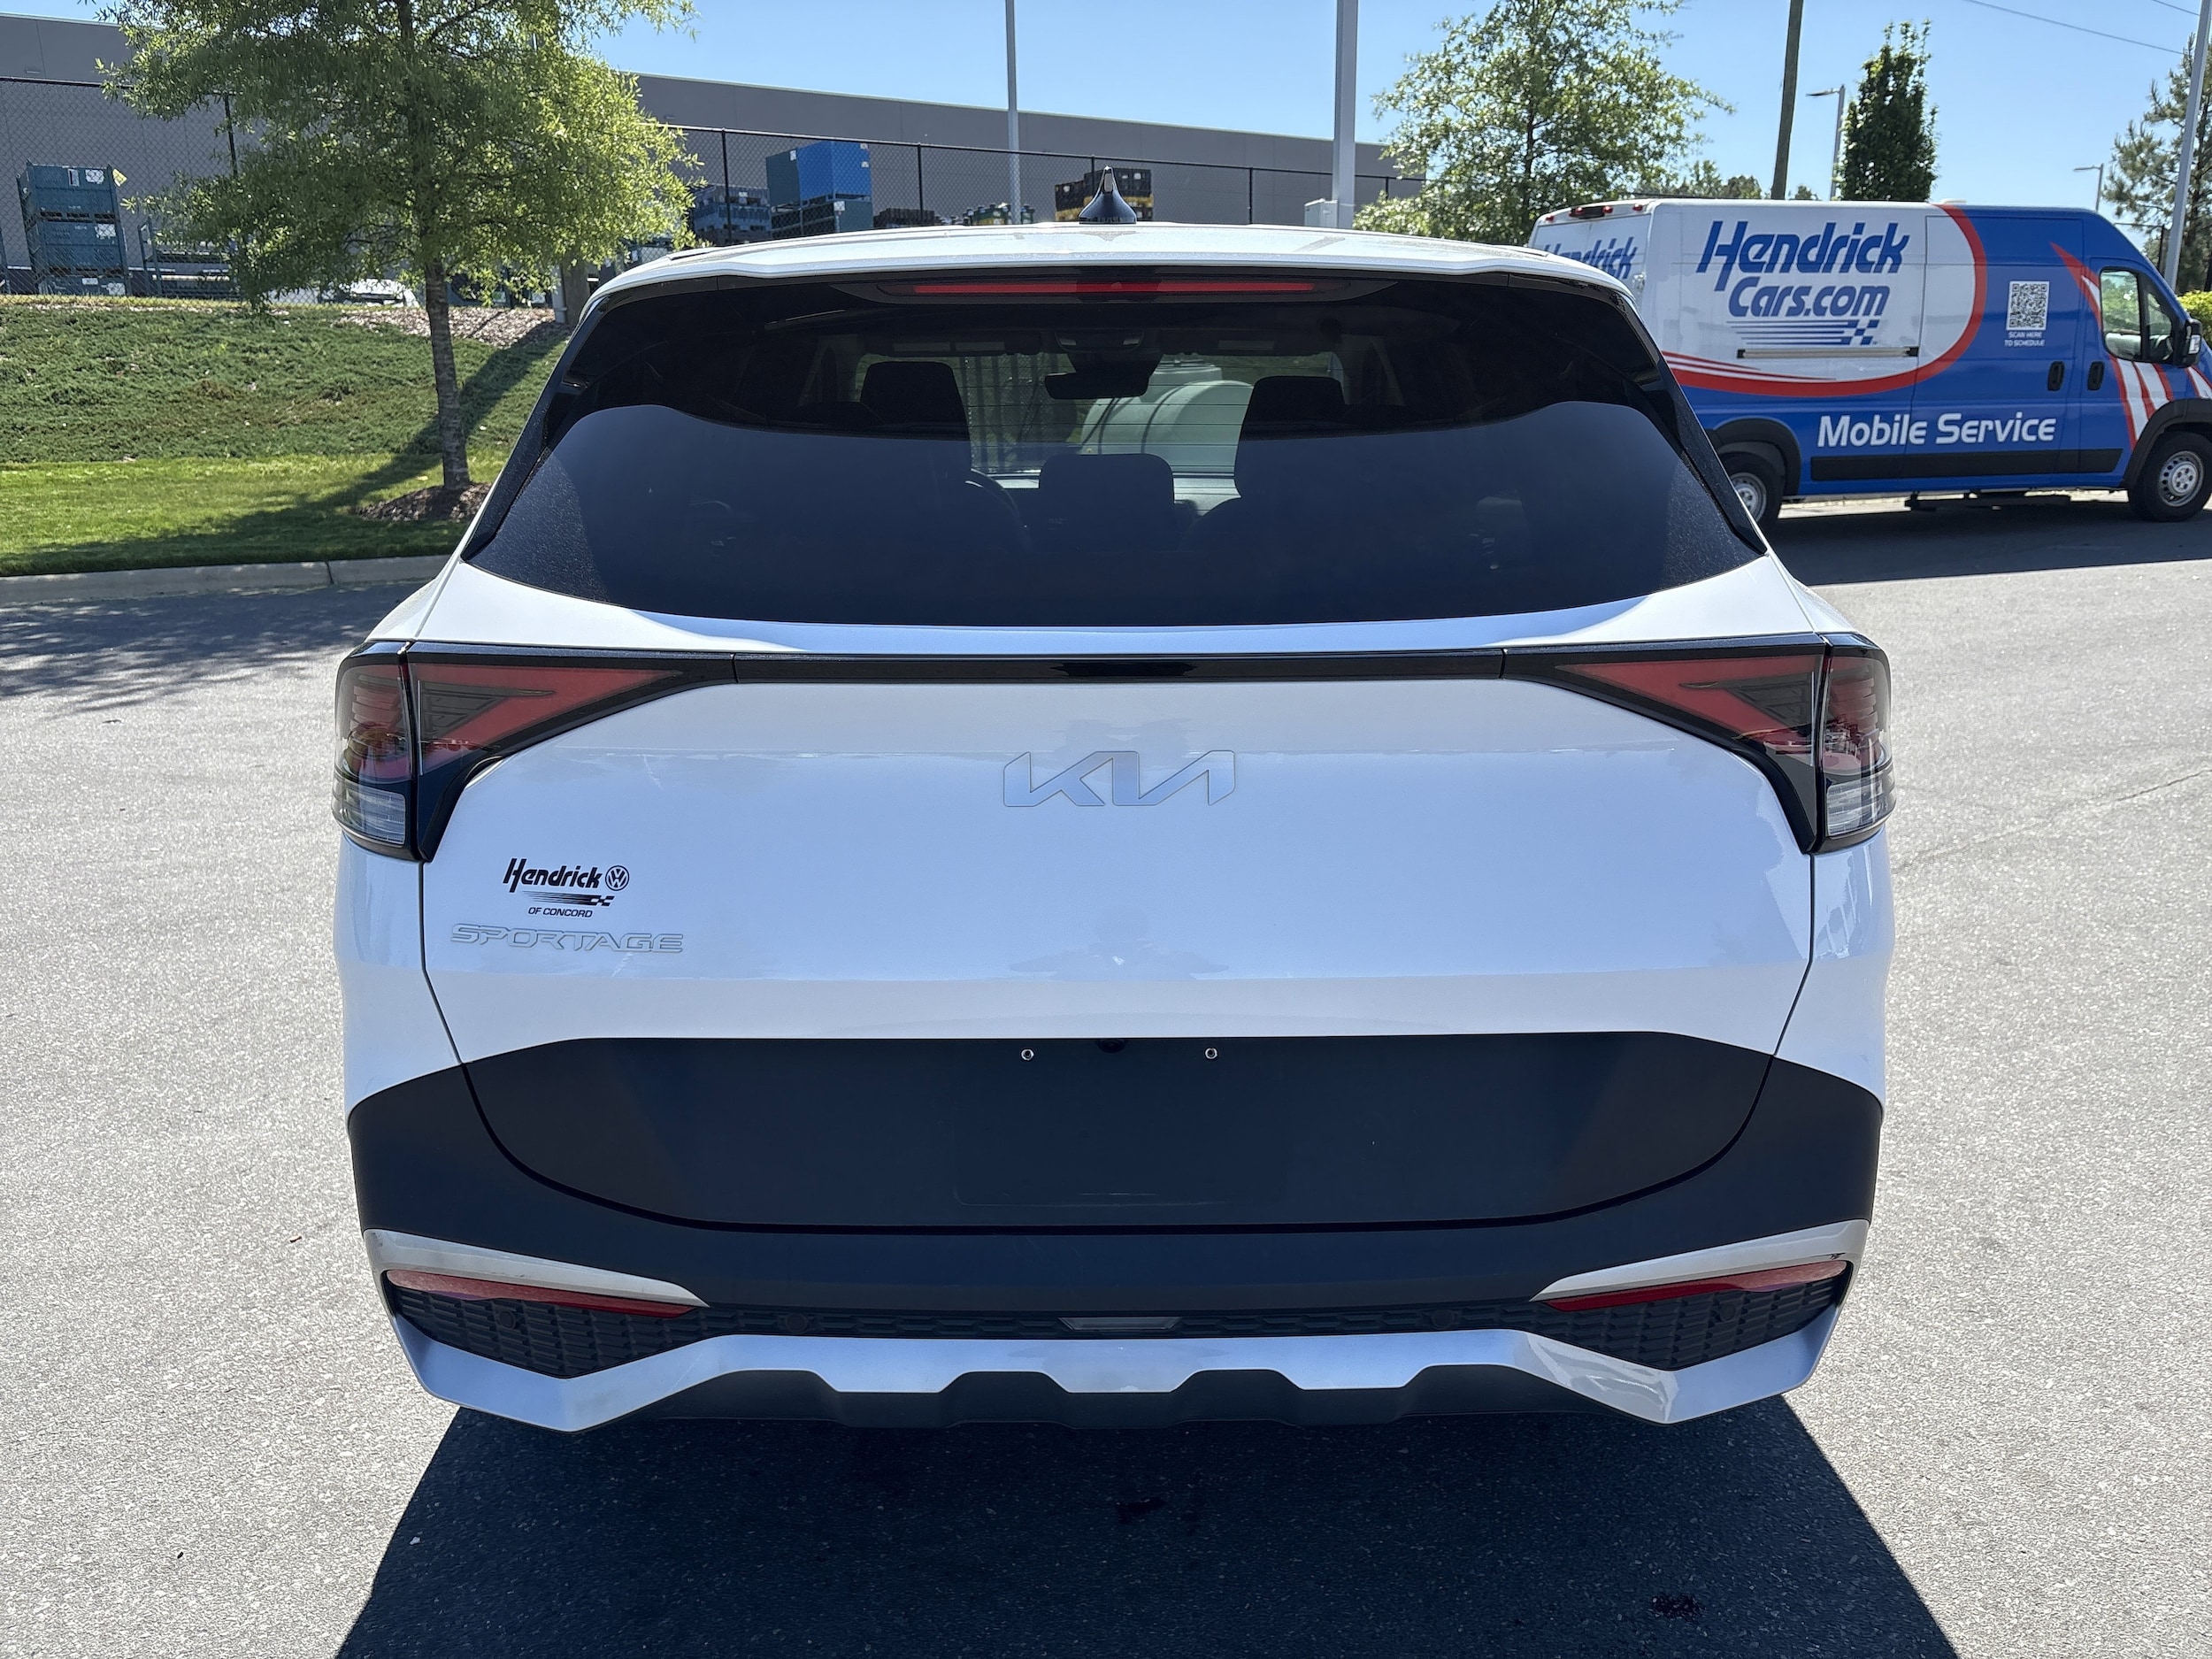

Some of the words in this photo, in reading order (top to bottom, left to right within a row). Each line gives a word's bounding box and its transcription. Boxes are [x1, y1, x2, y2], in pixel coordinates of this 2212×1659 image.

[1543, 236, 1638, 280] drick
[1695, 220, 1910, 292] Hendrick
[1728, 276, 1891, 318] Cars.com
[1817, 414, 1928, 448] Mobile
[1935, 411, 2057, 444] Service
[1002, 749, 1235, 807] KIA
[503, 857, 602, 893] Hendrick
[542, 908, 593, 918] CONCORD
[450, 923, 684, 954] SPORTAGE
